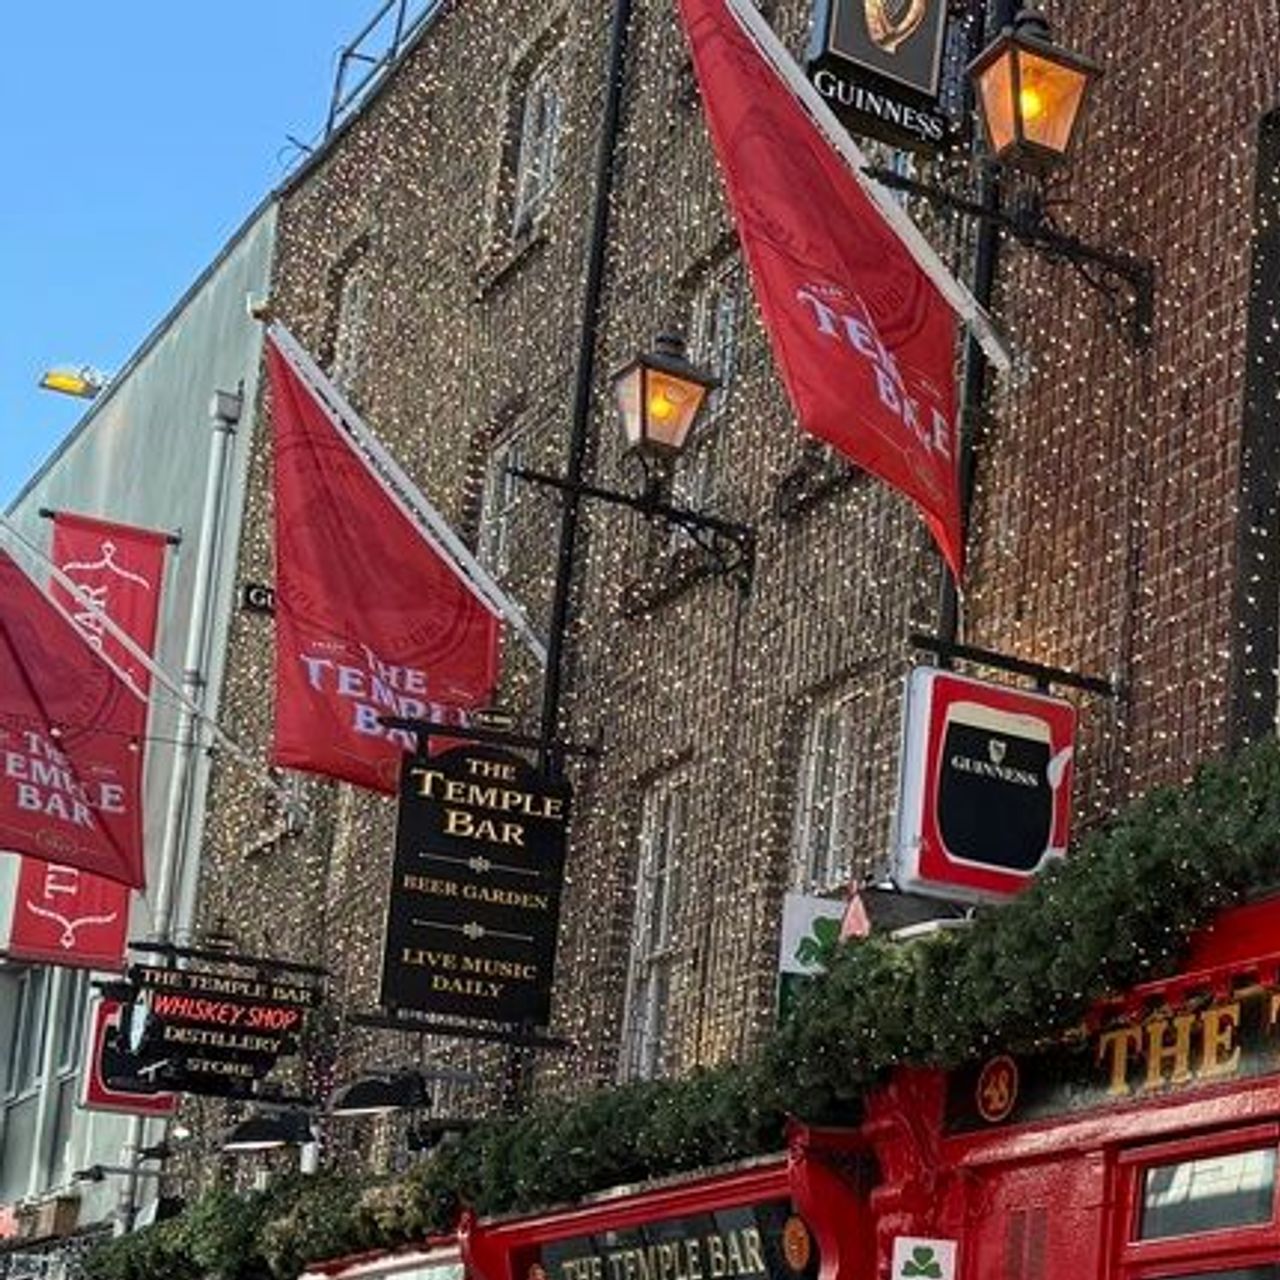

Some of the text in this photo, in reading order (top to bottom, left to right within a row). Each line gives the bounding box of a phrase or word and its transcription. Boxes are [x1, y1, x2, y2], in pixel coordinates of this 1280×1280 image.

[814, 70, 944, 141] GUINNESS
[466, 757, 517, 781] THE
[951, 755, 1038, 787] GUINNESS
[18, 783, 94, 831] BAR
[410, 767, 564, 820] TEMPLE
[443, 807, 525, 846] BAR
[403, 873, 459, 897] BEER
[463, 882, 549, 910] GARDEN
[402, 947, 459, 970] LIVE
[461, 956, 537, 981] MUSIC
[140, 967, 183, 986] THE
[186, 973, 267, 999] TEMPLE
[431, 974, 504, 998] DAILY
[153, 994, 299, 1030] WHISKEY SHOP
[164, 1025, 282, 1052] DISTILLERY
[1101, 1002, 1240, 1096] THE
[186, 1057, 254, 1077] STORE
[706, 1225, 766, 1277] BAR
